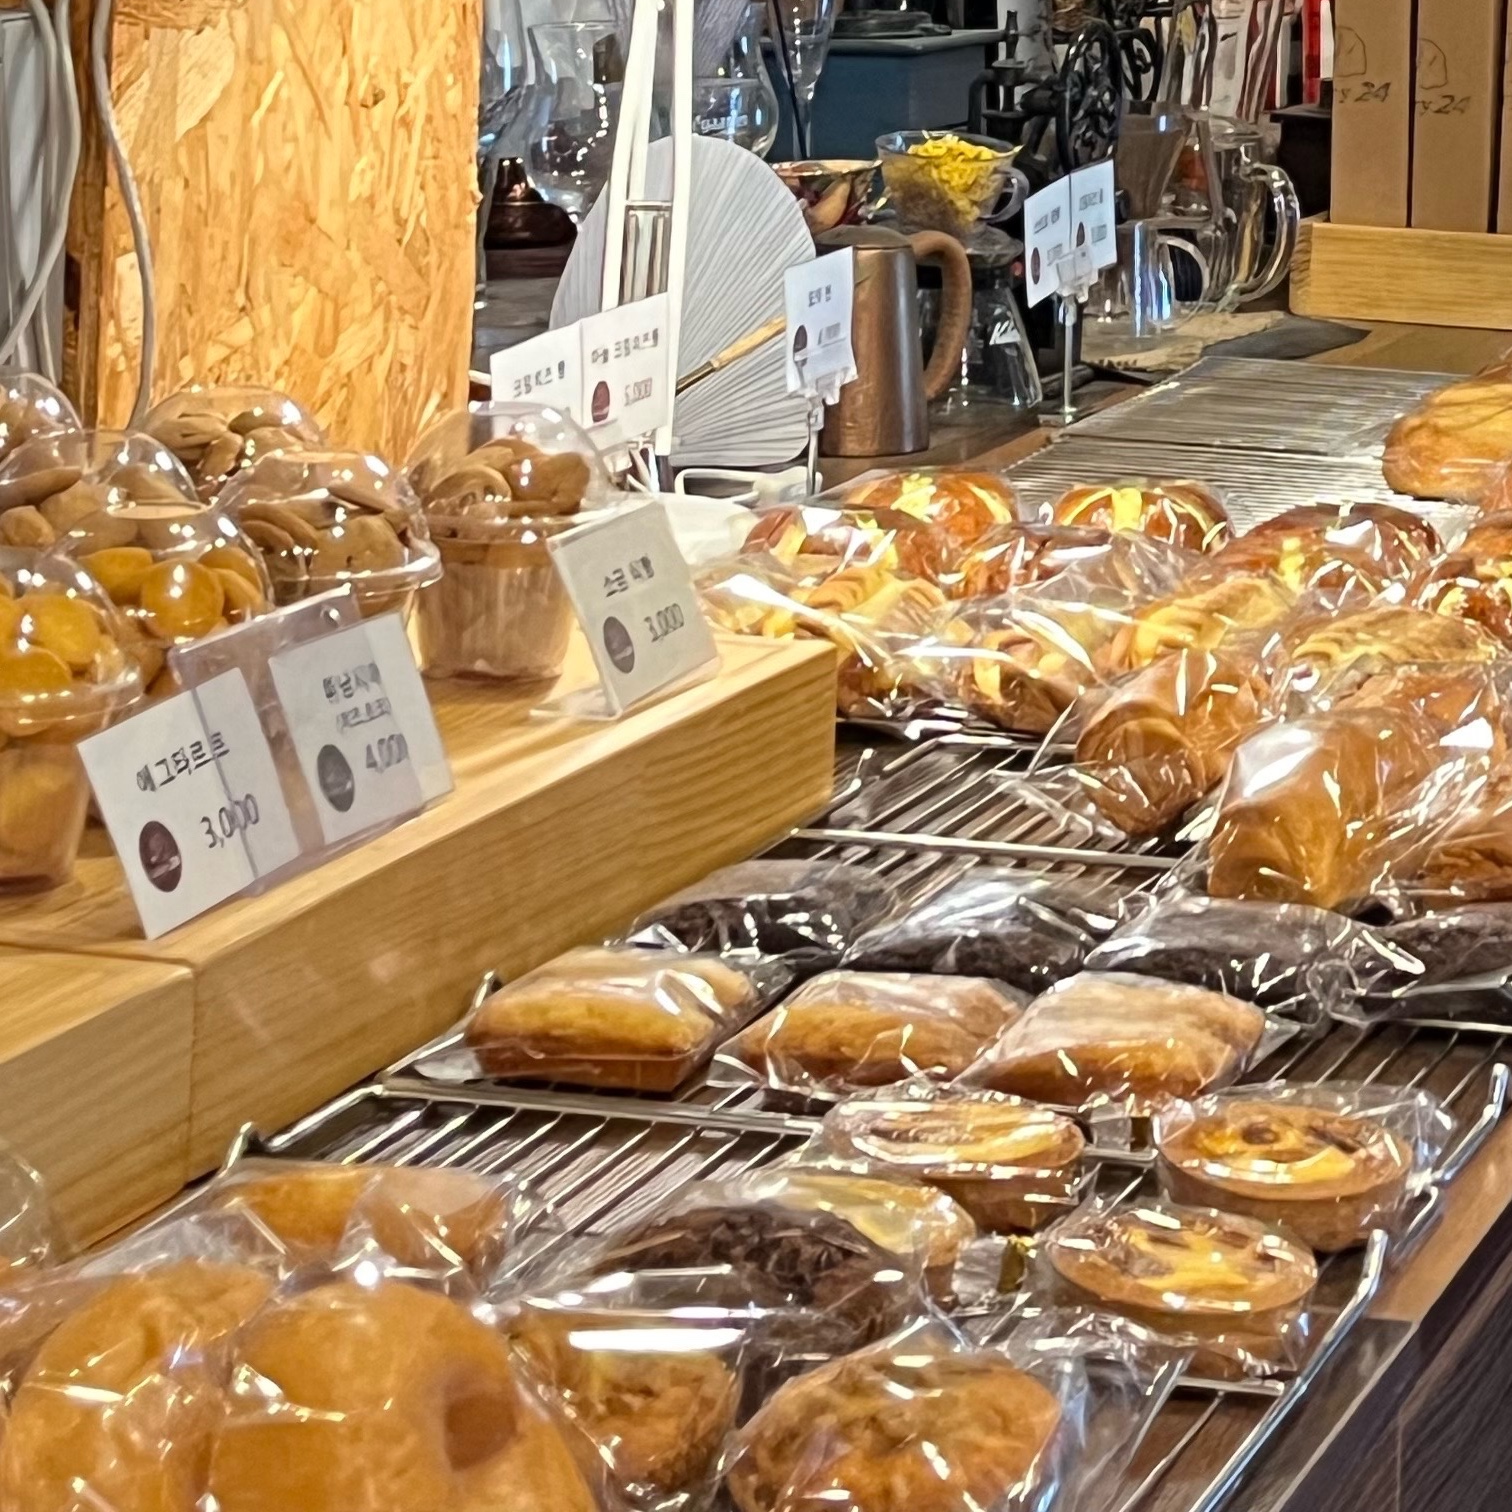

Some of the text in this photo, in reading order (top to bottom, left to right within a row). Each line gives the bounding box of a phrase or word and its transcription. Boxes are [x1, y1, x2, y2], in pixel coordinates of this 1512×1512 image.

[1354, 82, 1392, 103] 24
[1434, 94, 1472, 115] 24
[136, 731, 230, 792] 에그타르트
[200, 792, 260, 849] 3,000
